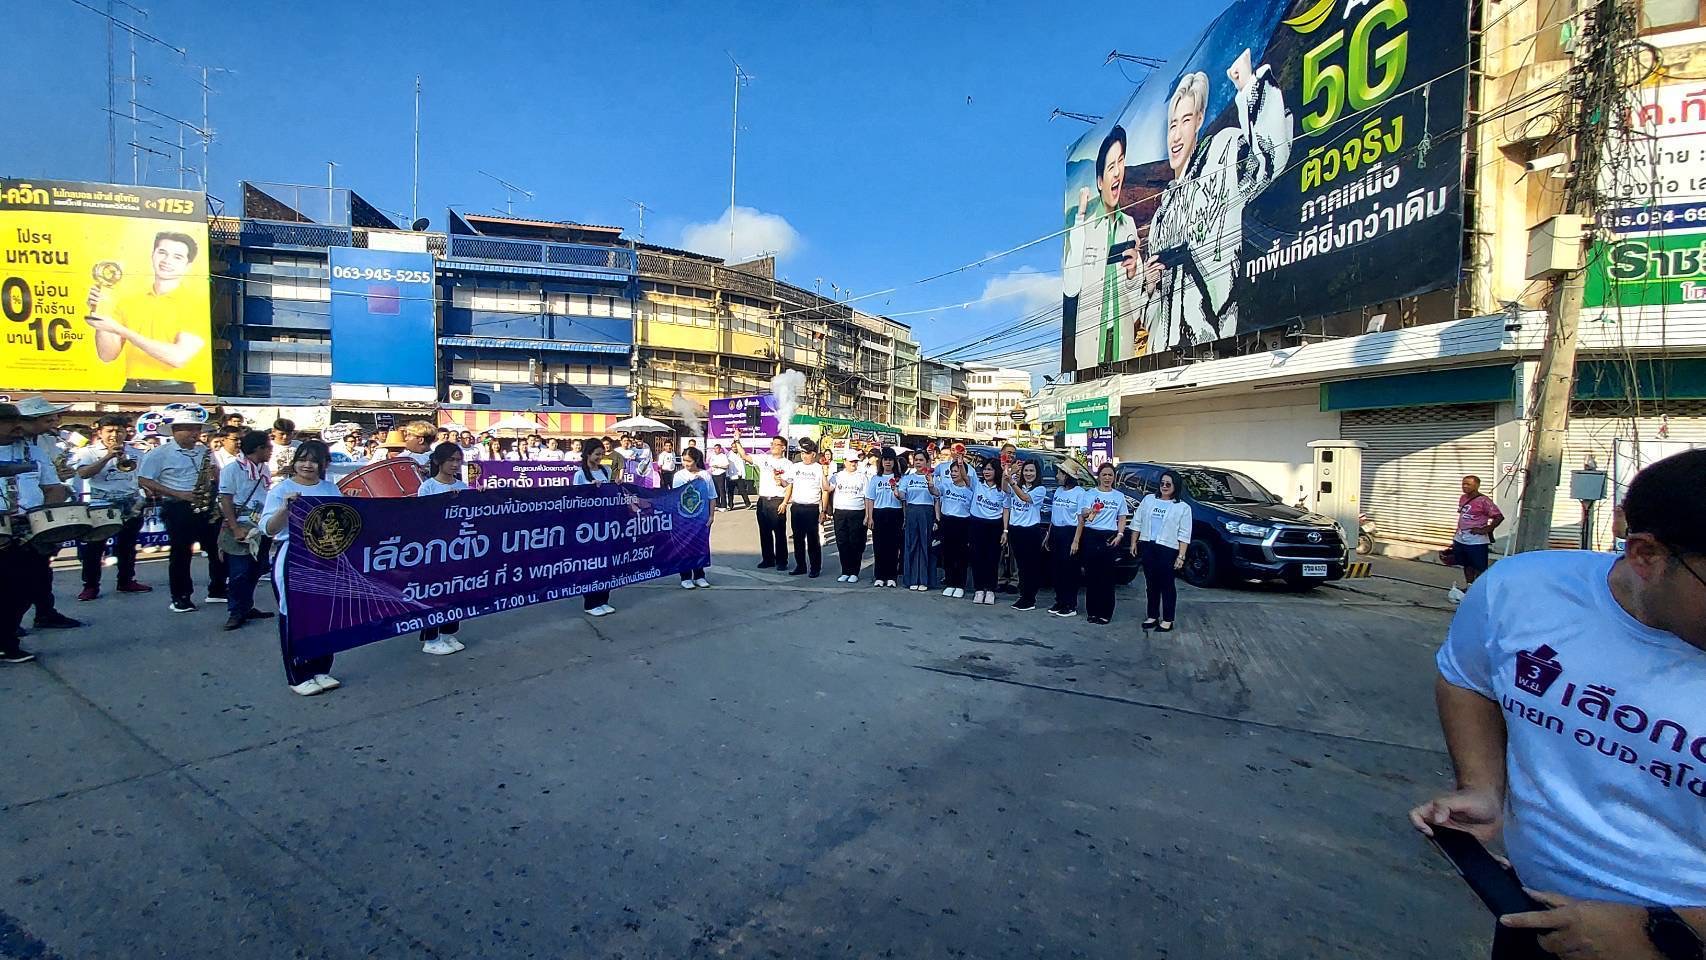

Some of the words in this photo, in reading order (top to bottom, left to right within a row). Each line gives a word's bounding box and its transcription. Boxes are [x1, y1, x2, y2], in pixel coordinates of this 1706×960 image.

[1301, 0, 1408, 137] 5G
[1301, 115, 1404, 194] ตัวจริง
[158, 197, 194, 215] 1153
[1301, 161, 1401, 223] ภาคเหนือ
[17, 228, 52, 244] โปรฯ
[1246, 186, 1448, 283] ทุกพื้นที่ดียิ่งกว่าเดิม
[6, 249, 69, 265] มหาชน
[34, 280, 69, 297] ผ่อน
[333, 264, 431, 284] 063-945-5255
[34, 298, 75, 315] ทั้งร้าน
[483, 473, 533, 490] เลือกตั้ง
[538, 475, 570, 489] นายก
[363, 521, 490, 573] เลือกตั้ง
[501, 525, 565, 553] นายก
[575, 509, 673, 544] อบจ.สุโขทัย
[401, 570, 490, 602] วันอาทิตย์
[494, 563, 507, 586] ที่
[512, 566, 523, 582] 3
[529, 555, 608, 581] พฤศจิกายน
[612, 545, 655, 568] พ.ศ.2567
[396, 617, 424, 634] เวลา
[428, 607, 463, 626] 08.00
[467, 606, 480, 619] น.
[494, 594, 525, 613] 17.00
[527, 594, 540, 605] น.
[546, 590, 558, 601] ณ
[1528, 665, 1541, 679] 3
[1502, 694, 1565, 734] นายก
